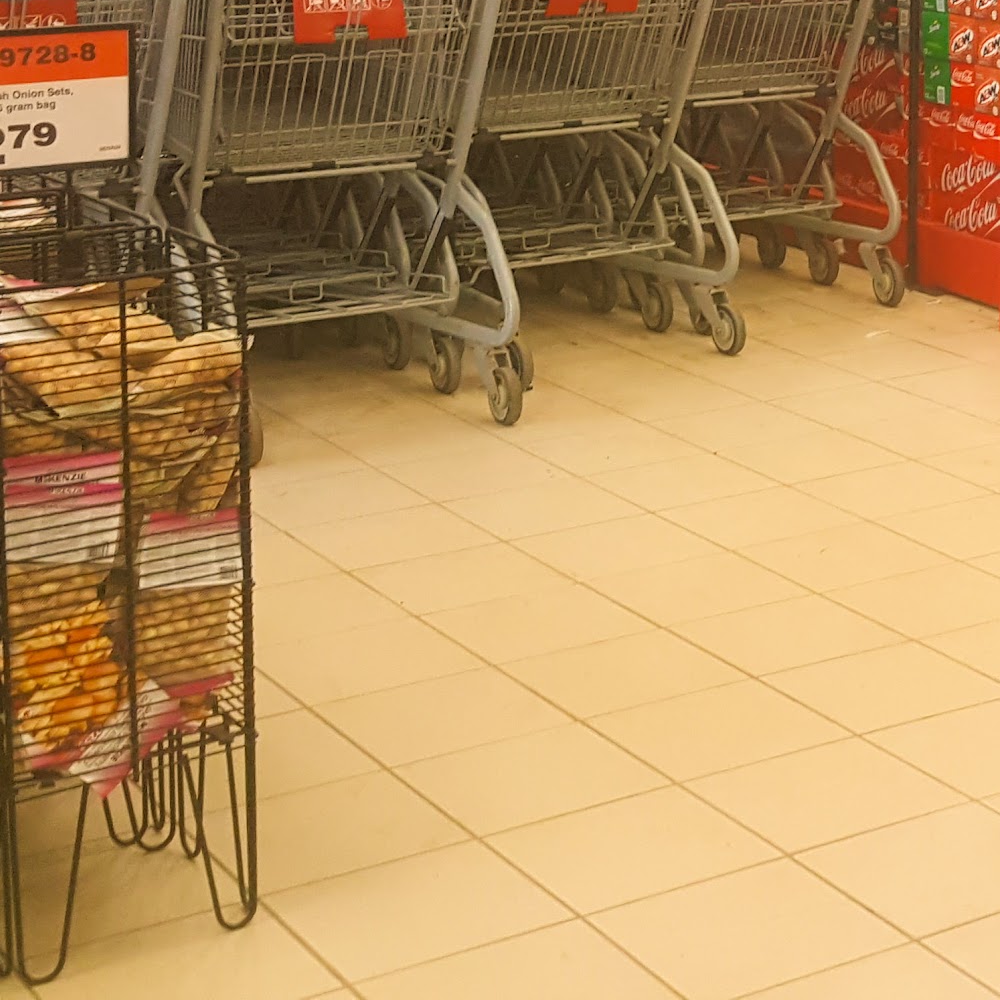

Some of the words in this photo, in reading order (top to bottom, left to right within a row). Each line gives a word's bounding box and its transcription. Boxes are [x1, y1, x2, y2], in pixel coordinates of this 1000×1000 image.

[953, 31, 973, 53] A&W
[0, 43, 96, 67] 9728-8
[13, 89, 45, 100] Onion
[47, 87, 74, 97] Sets,
[979, 83, 998, 104] A&W
[6, 104, 34, 114] gram
[36, 101, 56, 111] bag
[941, 156, 996, 194] Coca-Cola
